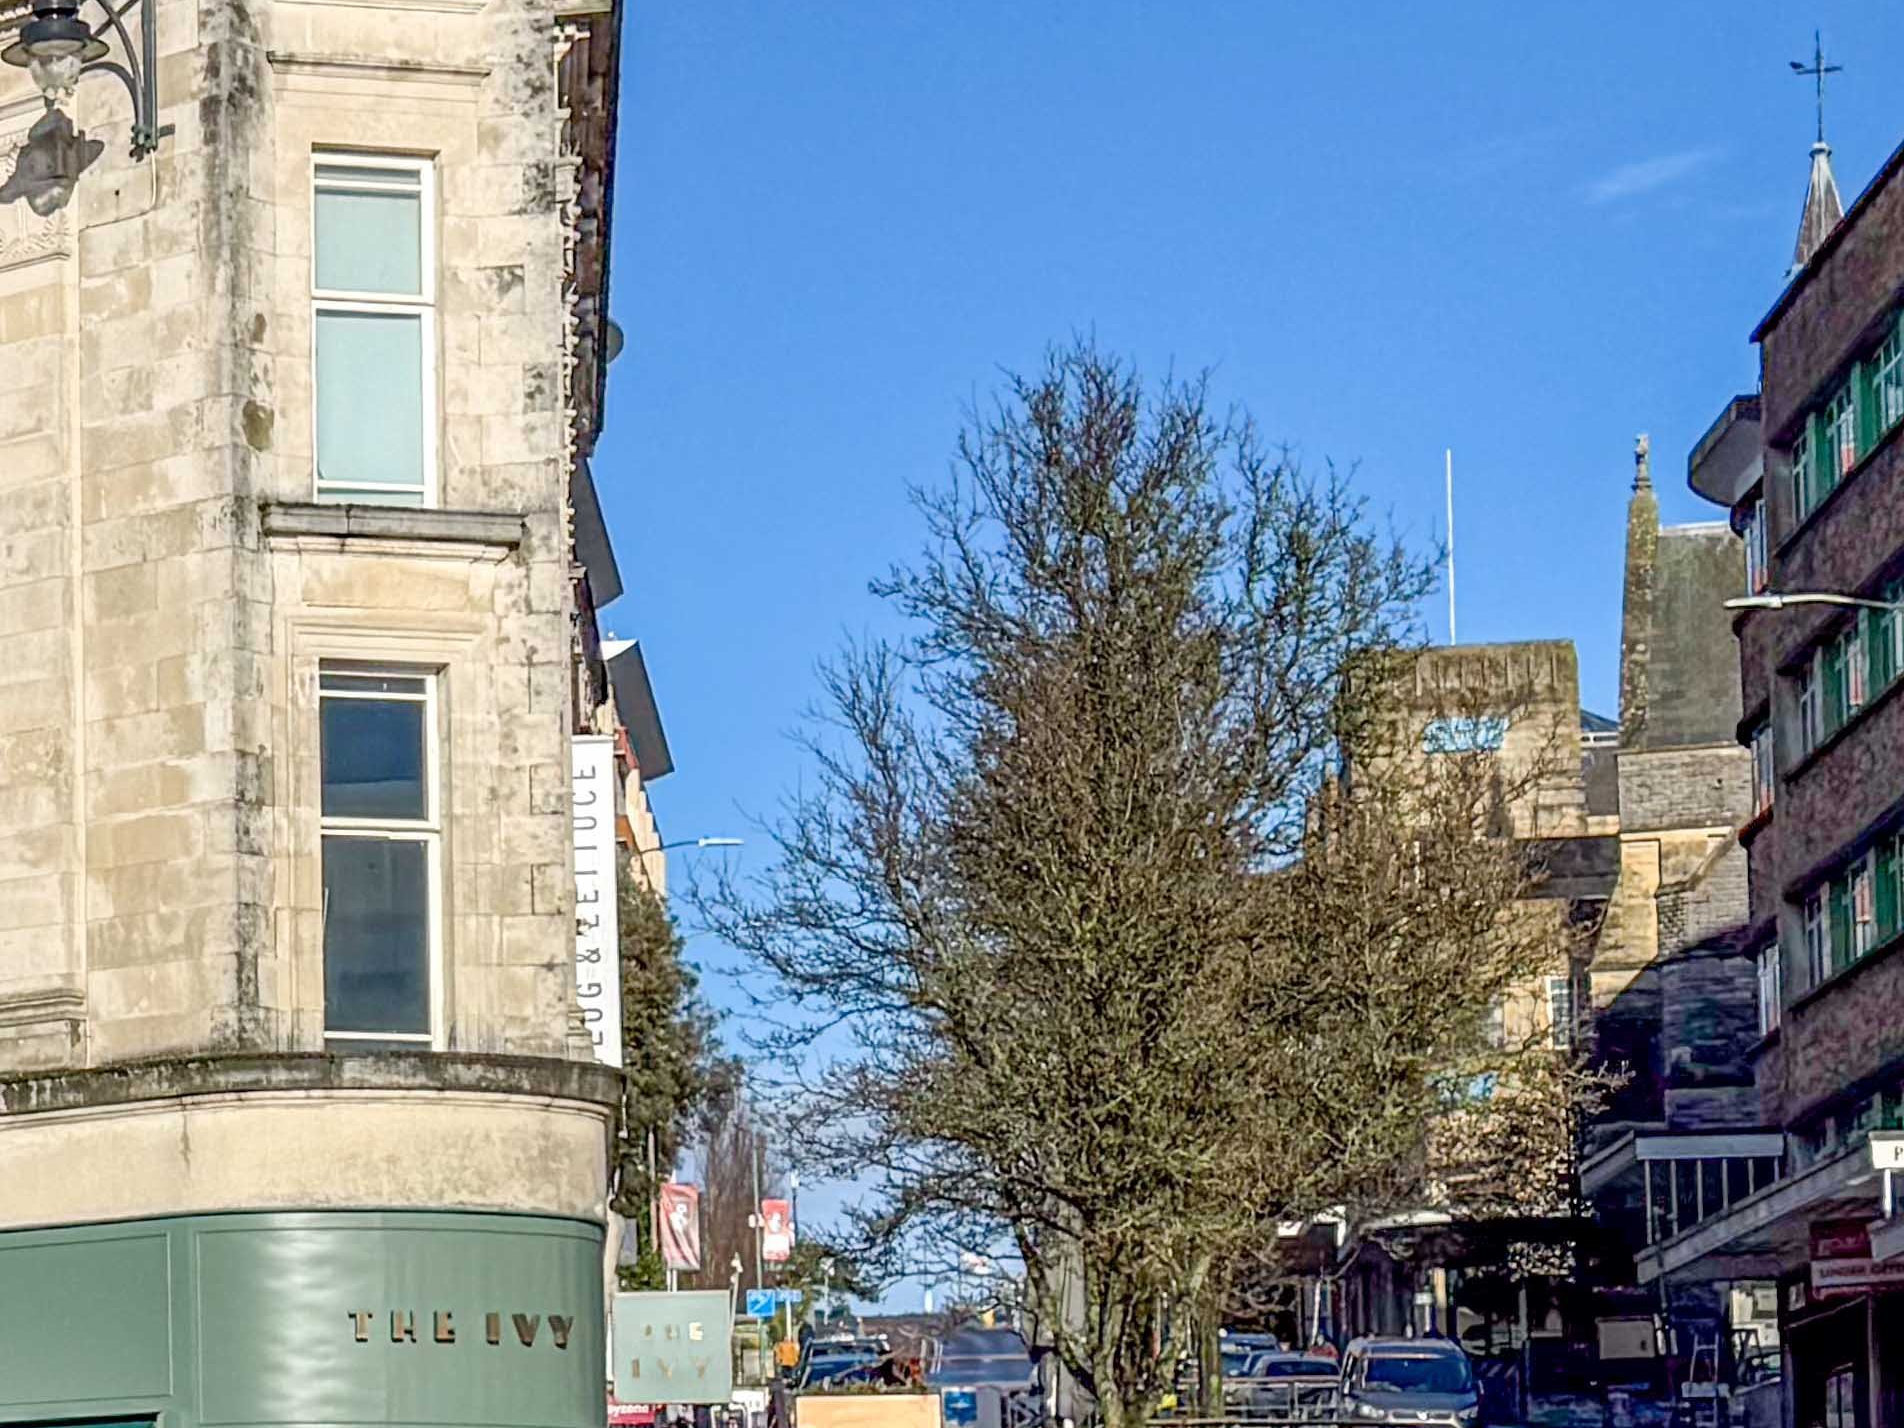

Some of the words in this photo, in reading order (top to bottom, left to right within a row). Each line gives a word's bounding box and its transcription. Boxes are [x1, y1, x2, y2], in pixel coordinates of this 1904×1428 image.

[576, 948, 601, 963] &
[348, 1310, 455, 1343] THE
[486, 1312, 574, 1350] IVY
